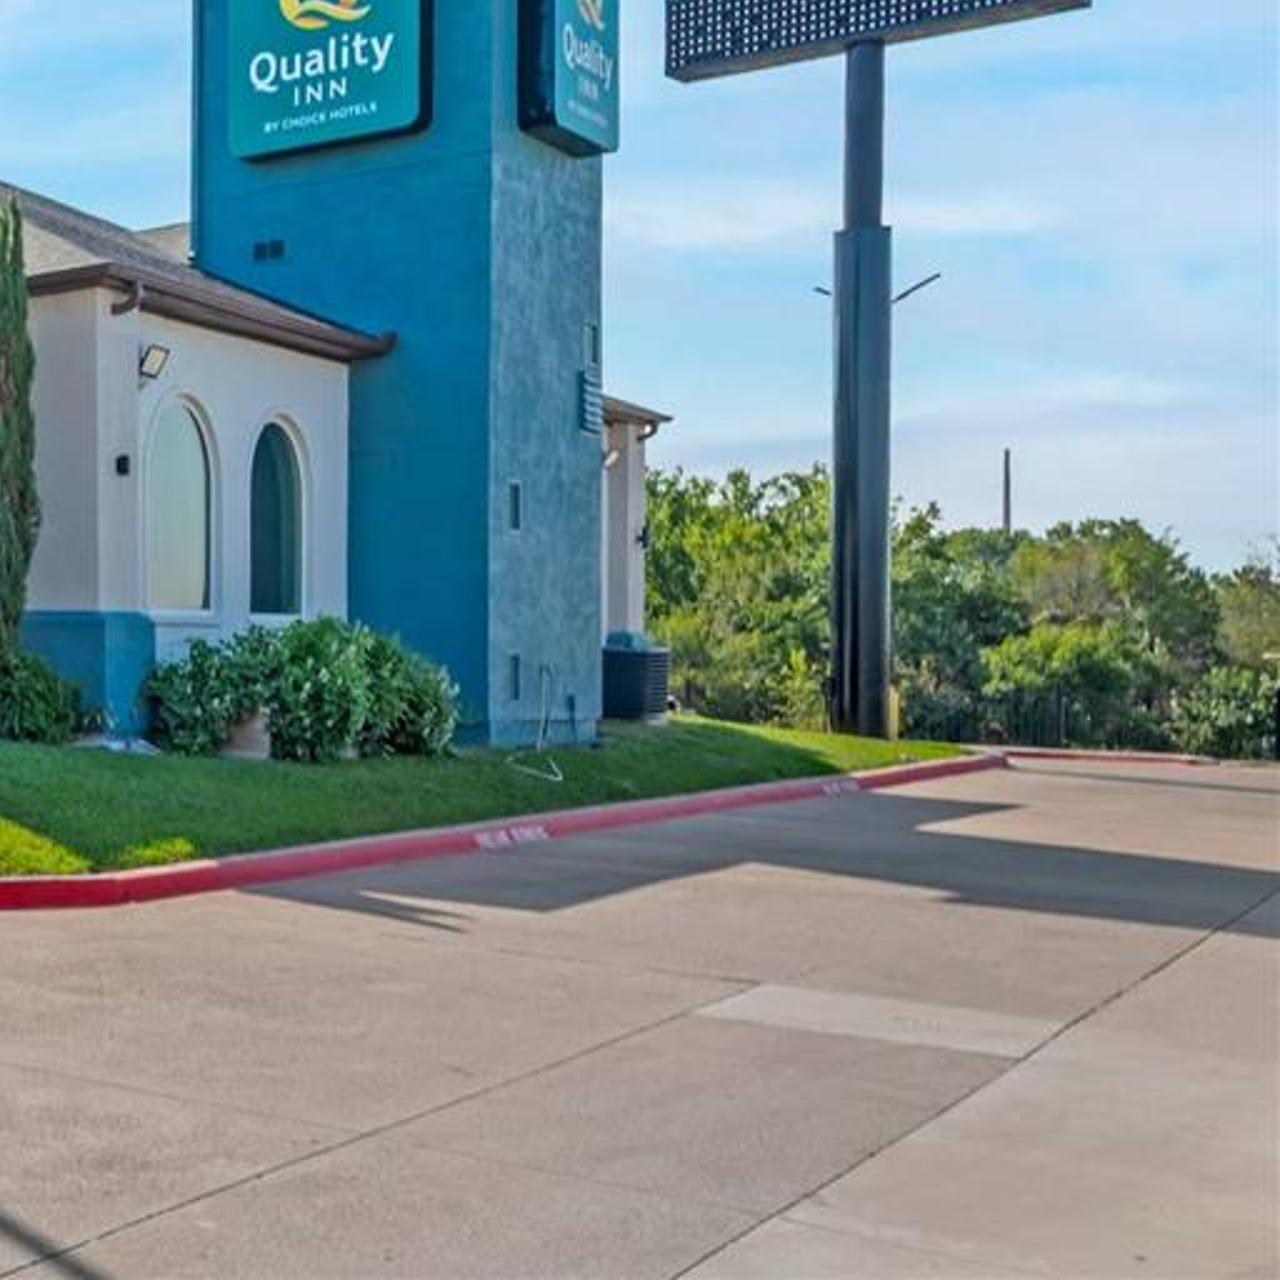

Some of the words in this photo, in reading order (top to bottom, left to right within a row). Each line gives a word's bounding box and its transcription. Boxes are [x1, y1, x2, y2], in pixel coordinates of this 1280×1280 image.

[249, 32, 395, 93] Quality
[563, 22, 612, 91] Quality
[294, 76, 347, 107] INN
[264, 121, 279, 133] BY
[281, 112, 326, 130] CHOICE
[329, 101, 378, 120] HOTELS
